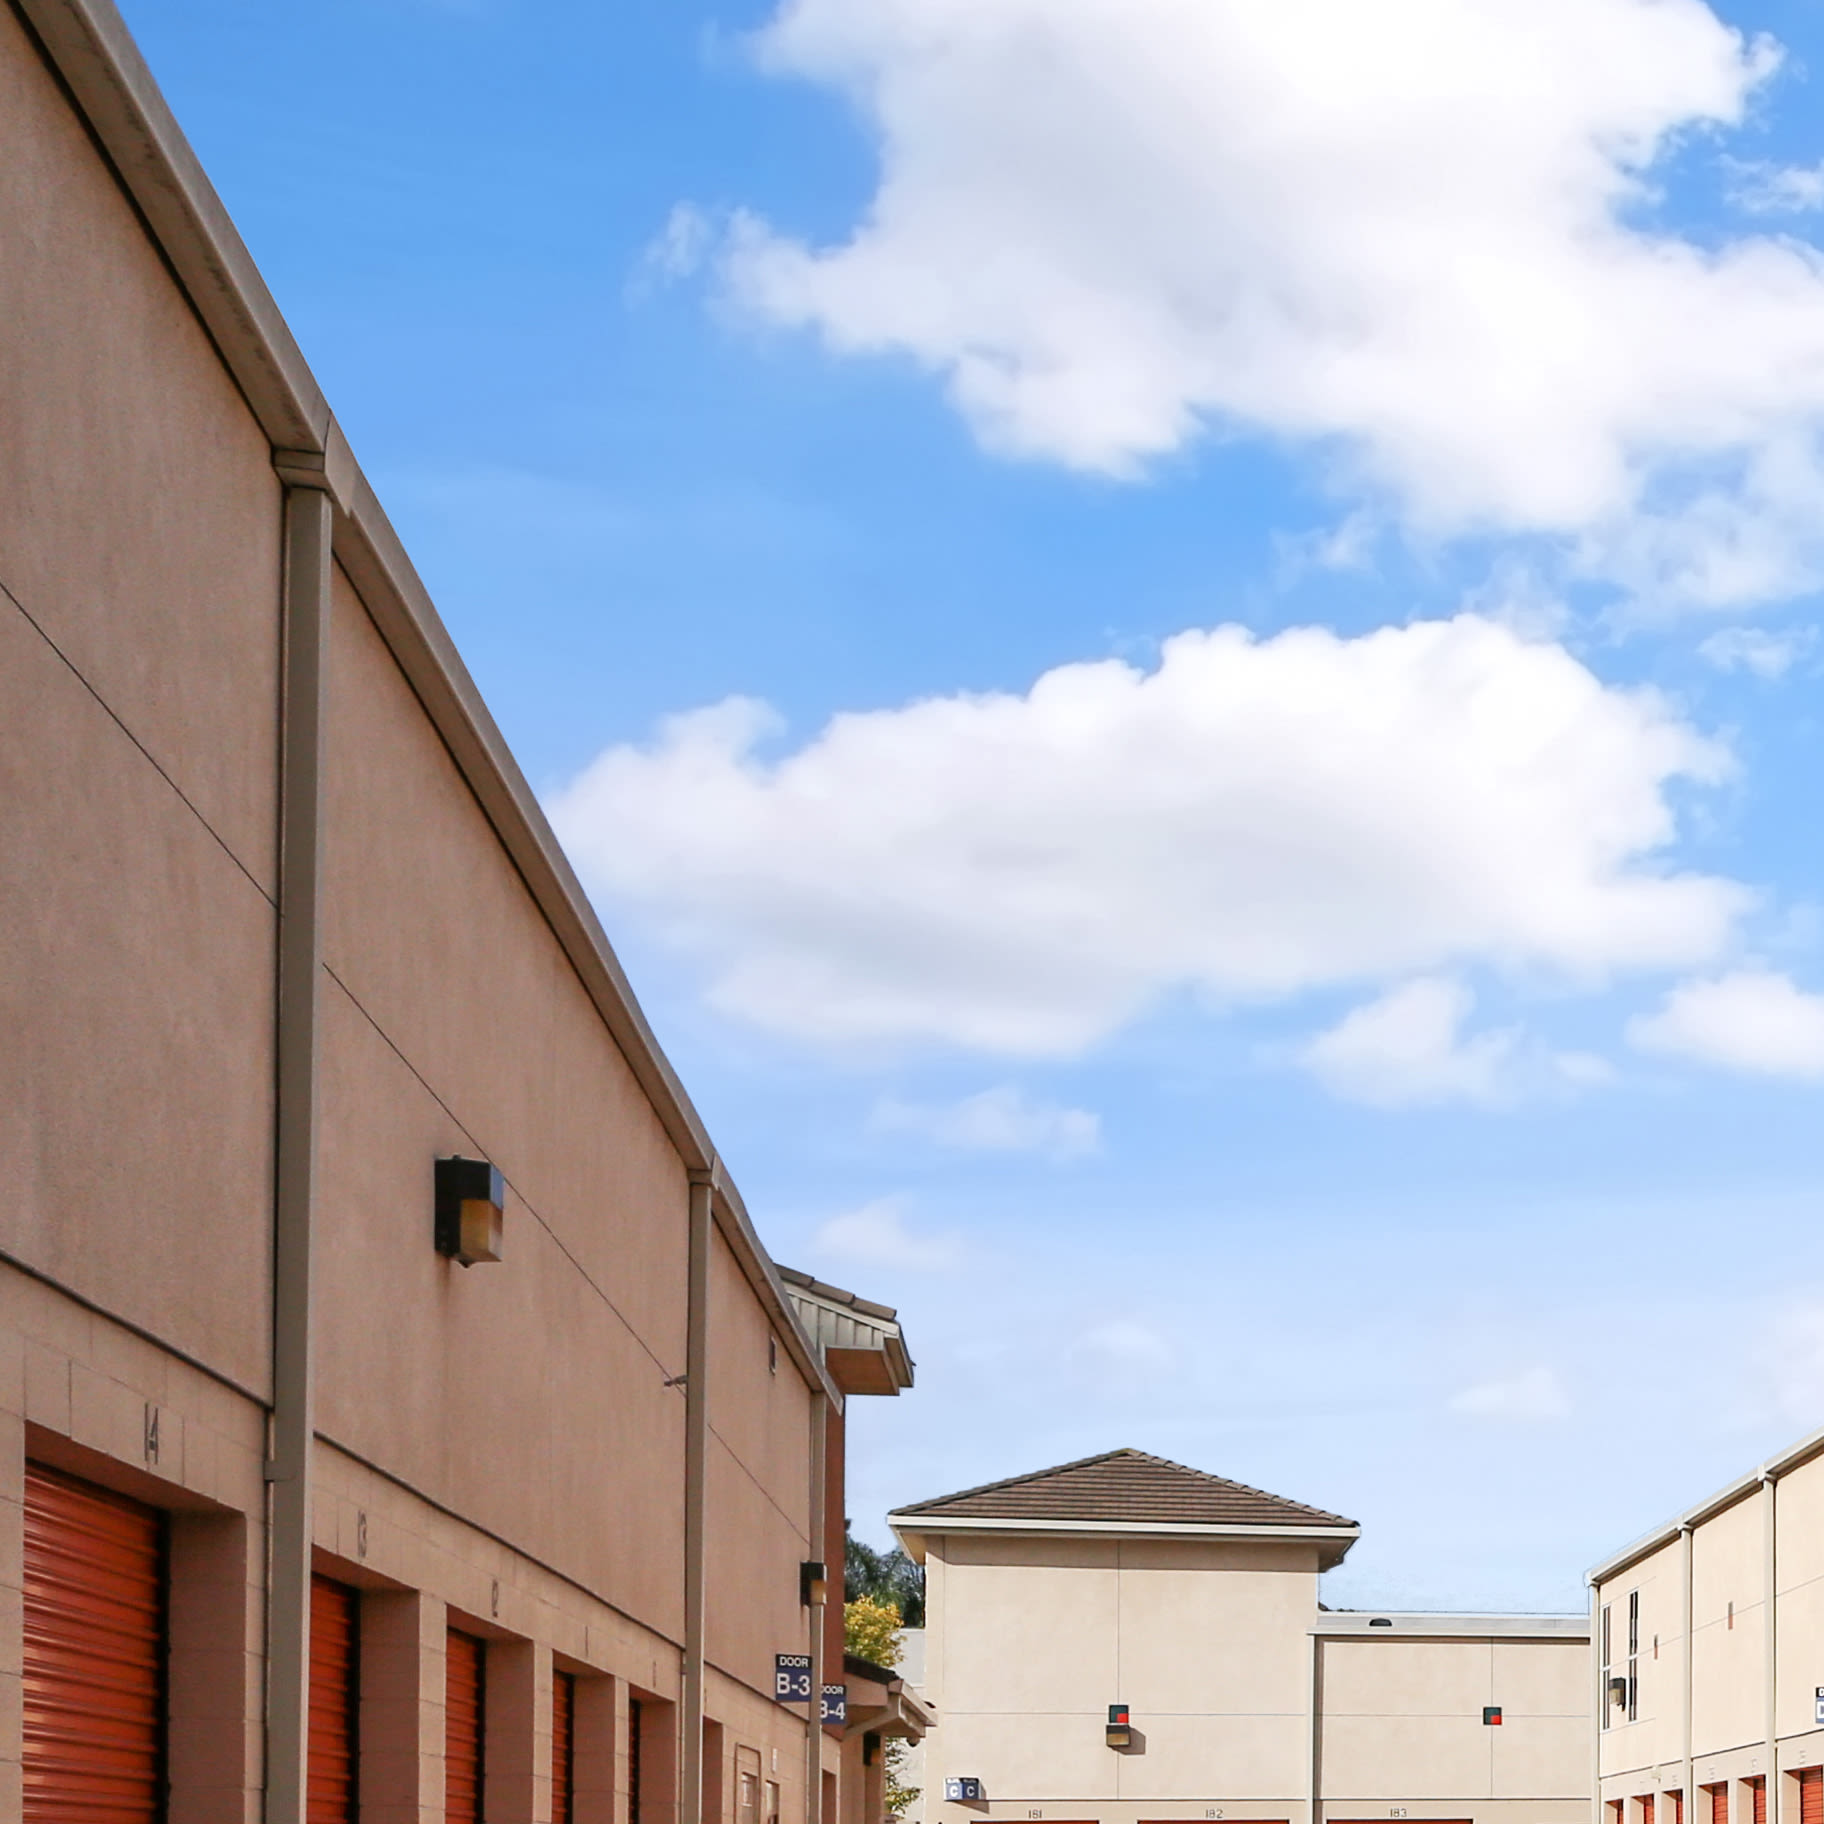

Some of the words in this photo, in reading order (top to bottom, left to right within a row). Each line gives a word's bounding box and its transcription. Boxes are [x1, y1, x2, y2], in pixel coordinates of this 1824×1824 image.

[144, 1402, 159, 1465] 14
[779, 1656, 809, 1668] DOOR
[776, 1672, 811, 1697] B-3
[966, 1785, 976, 1797] C
